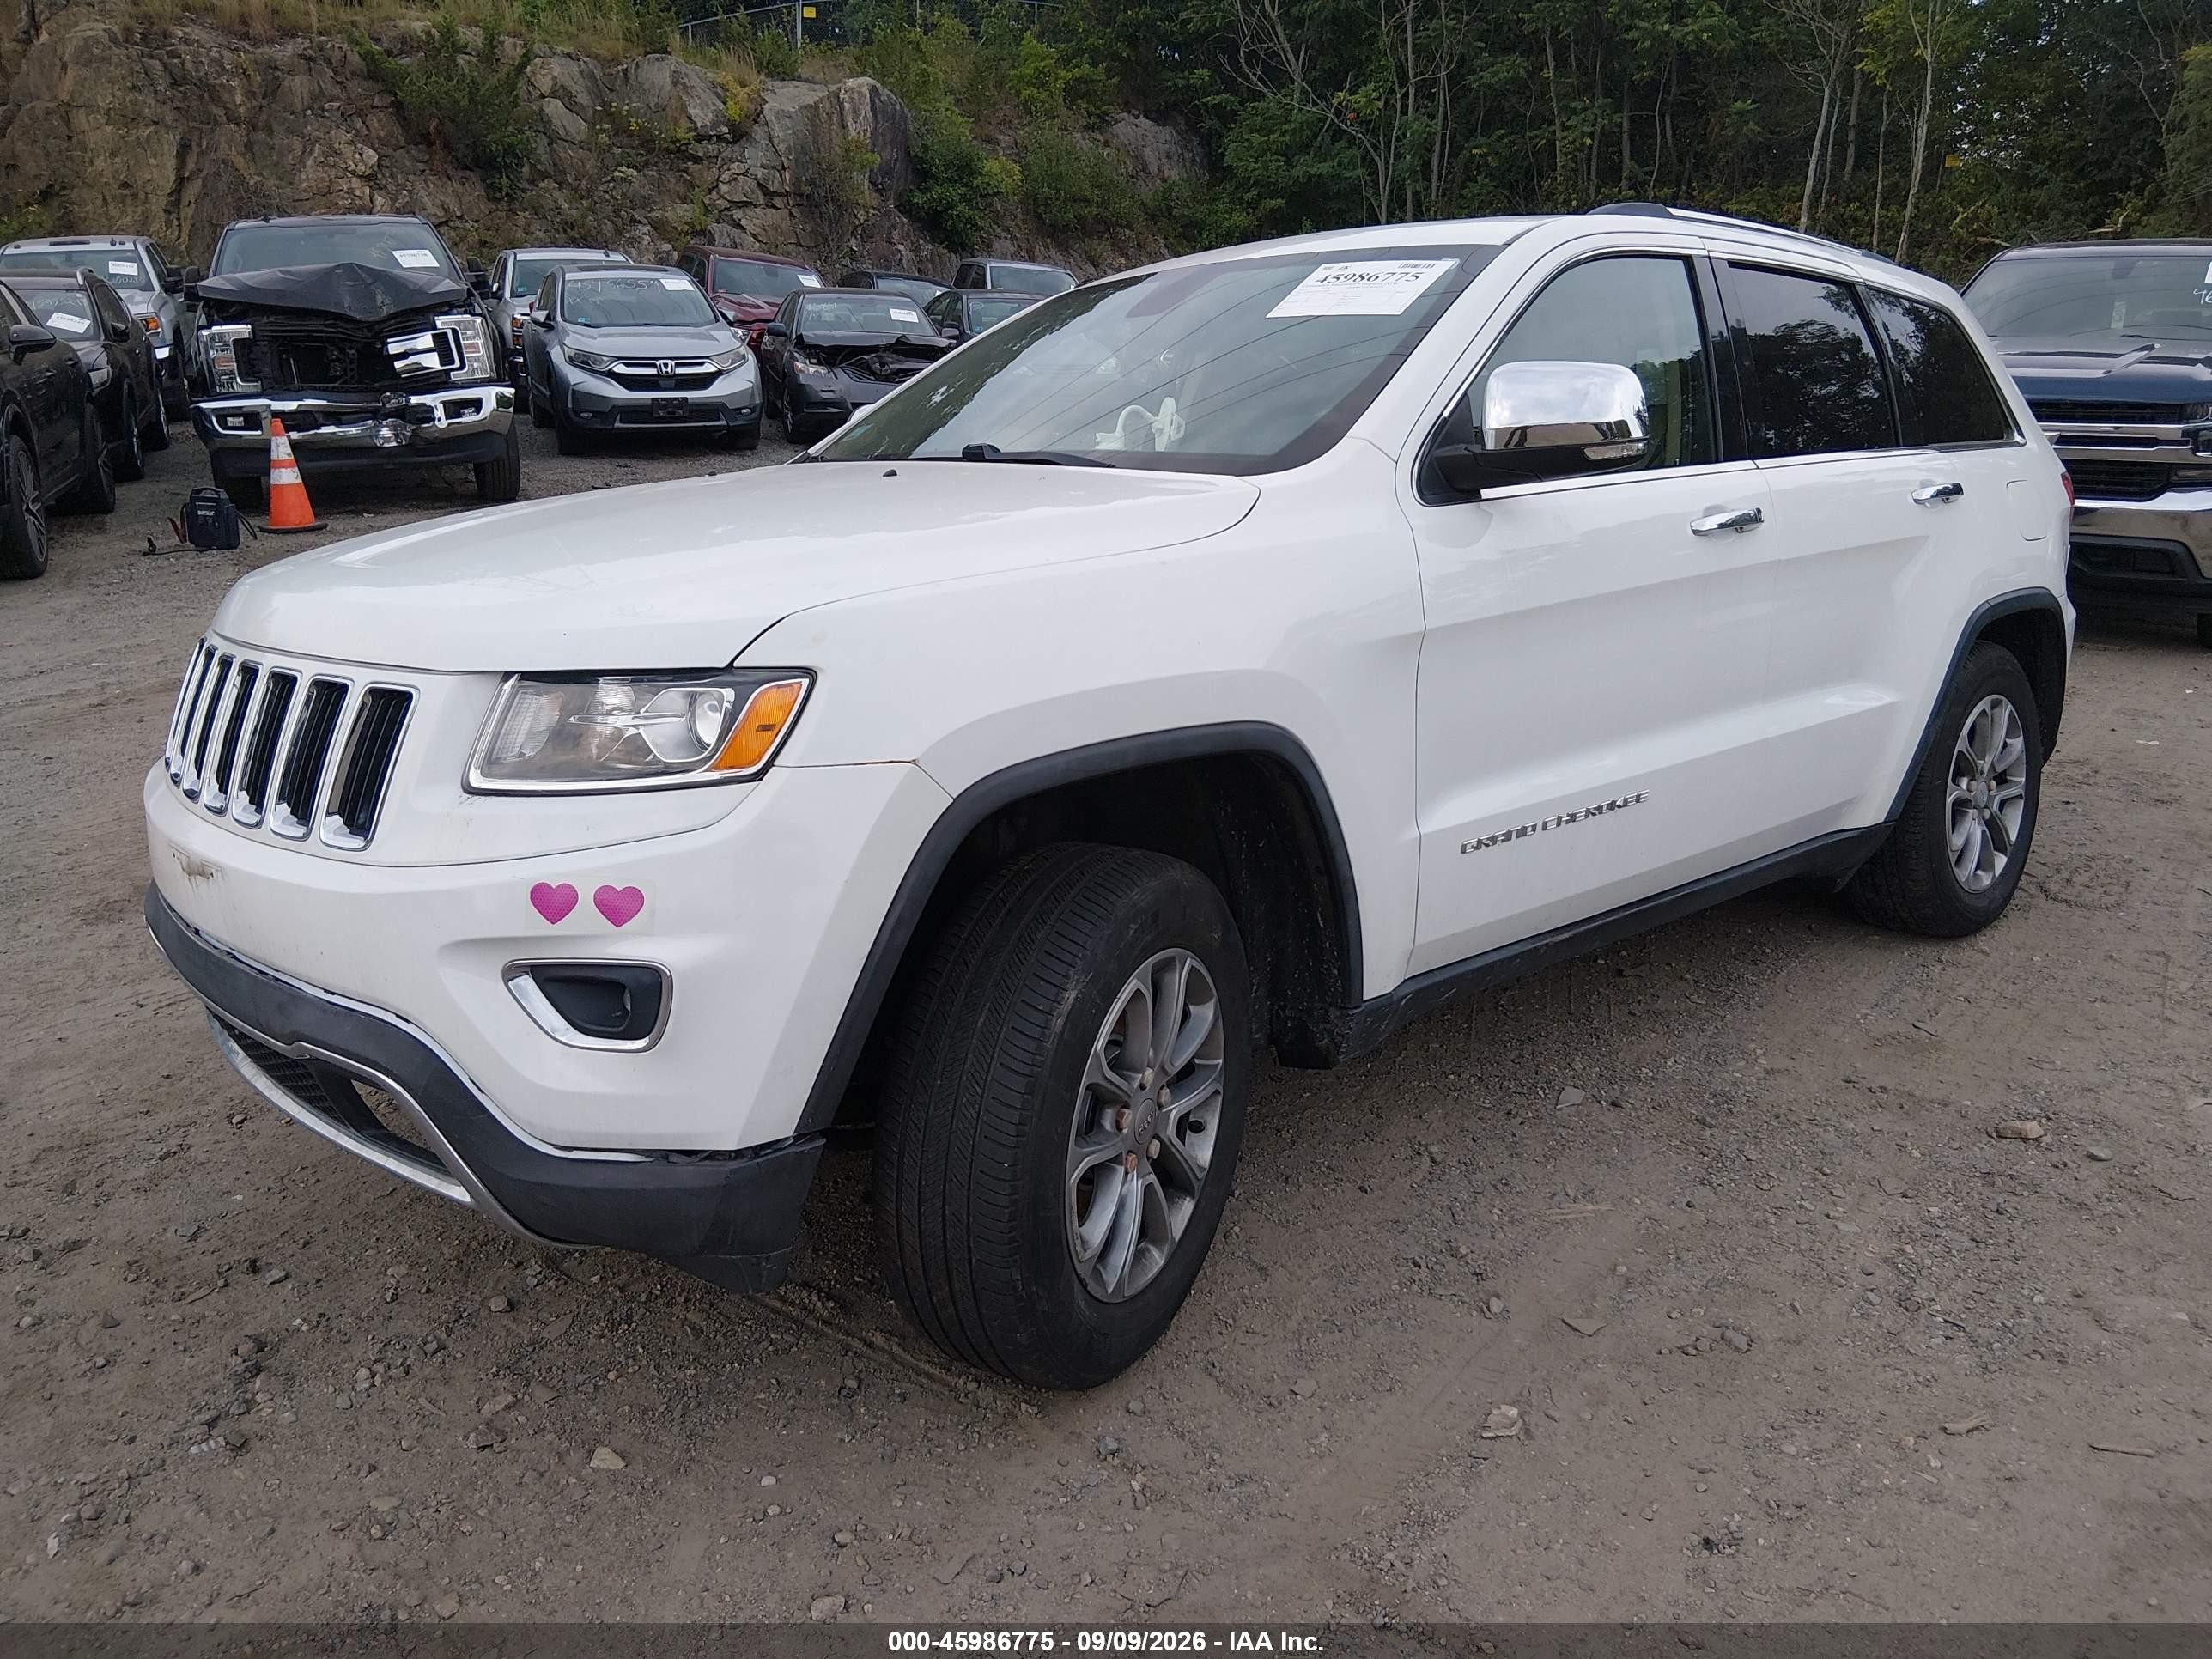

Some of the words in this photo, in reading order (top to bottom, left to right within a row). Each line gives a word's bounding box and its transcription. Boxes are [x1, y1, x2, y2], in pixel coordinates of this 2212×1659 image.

[1316, 271, 1424, 284] 45986775
[1461, 822, 1537, 854] GRAND
[1541, 789, 1650, 831] CHEROKEE
